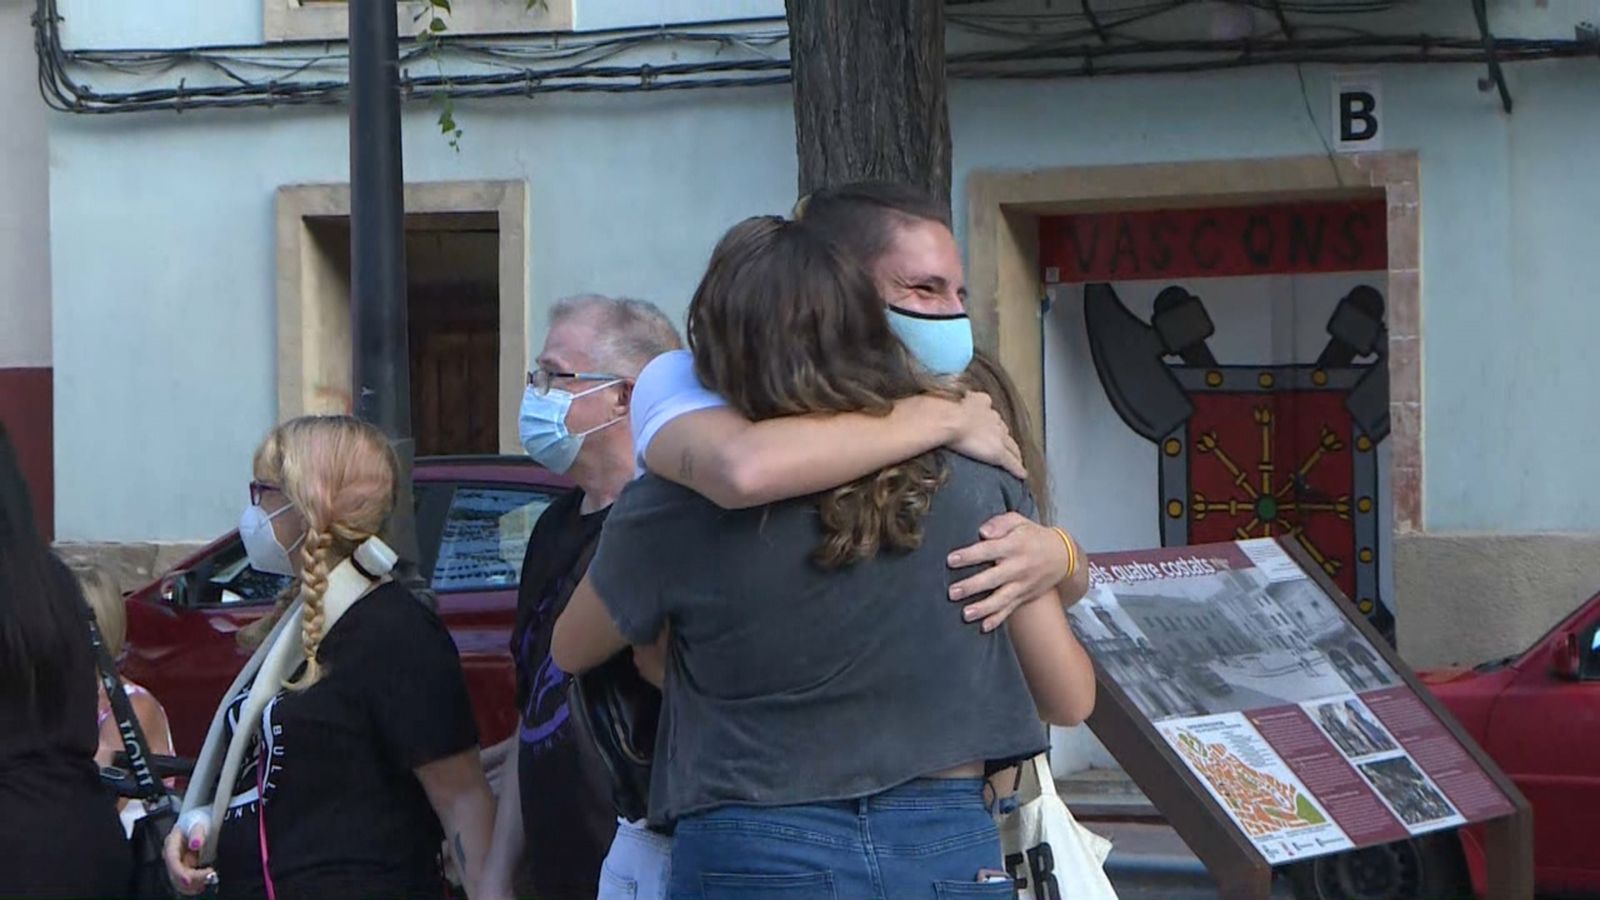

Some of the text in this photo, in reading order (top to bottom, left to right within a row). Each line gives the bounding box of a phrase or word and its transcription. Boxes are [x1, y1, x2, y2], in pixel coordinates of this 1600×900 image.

[1340, 91, 1378, 141] B
[1062, 208, 1373, 274] VASCONS
[1111, 562, 1163, 584] quatre
[1158, 556, 1215, 577] costats
